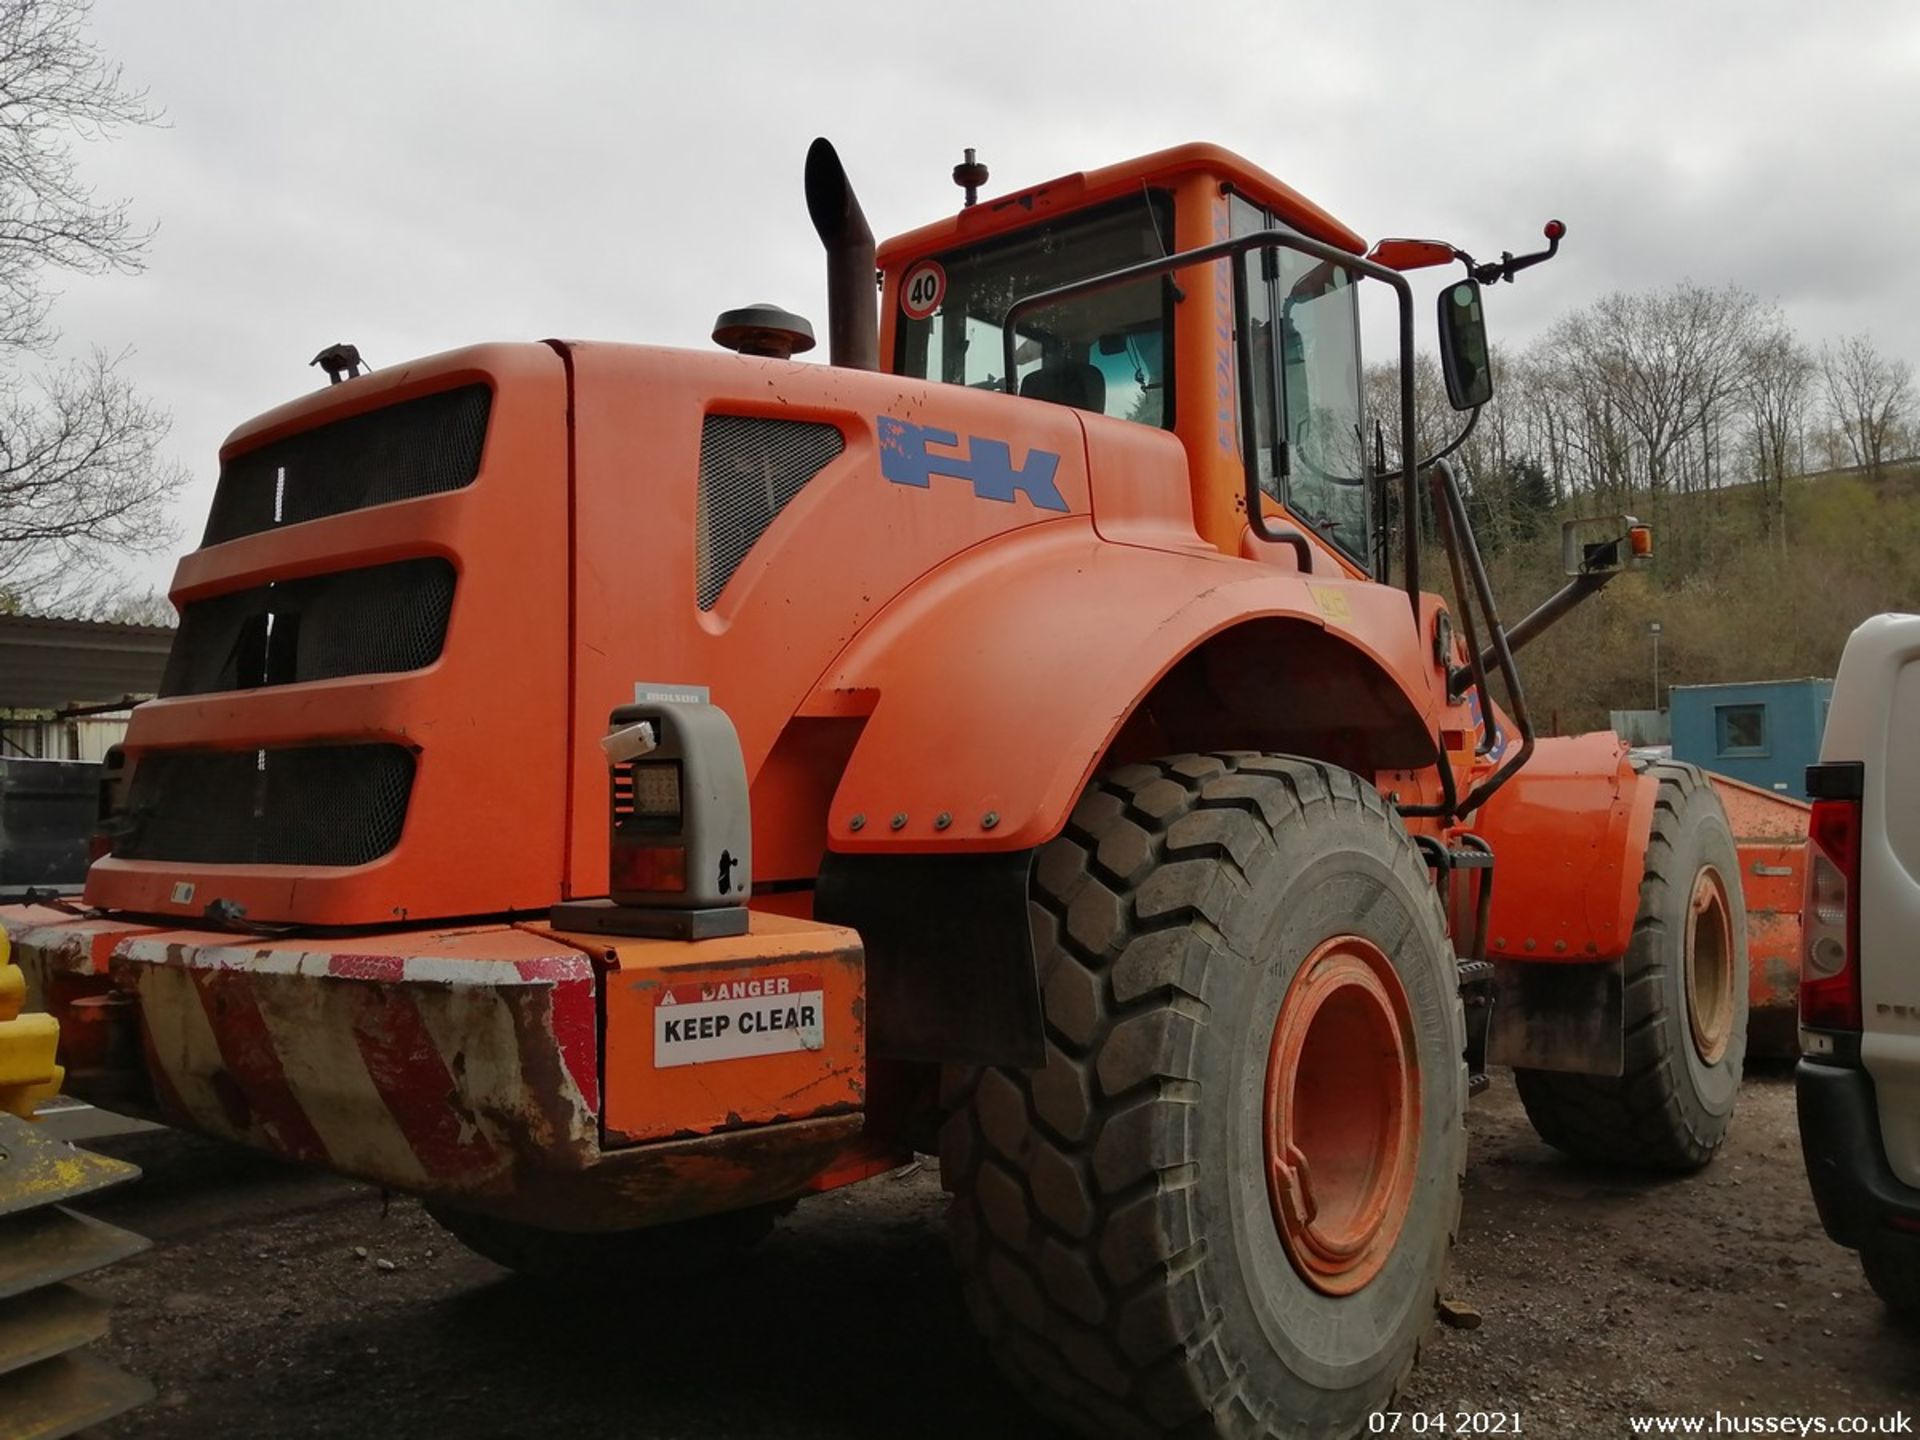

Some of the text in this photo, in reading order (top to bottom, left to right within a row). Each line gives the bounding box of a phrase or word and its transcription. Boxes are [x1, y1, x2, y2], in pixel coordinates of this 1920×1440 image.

[911, 275, 936, 304] 40
[702, 978, 789, 1001] DANGER
[665, 1005, 815, 1043] KEEP CLEAR
